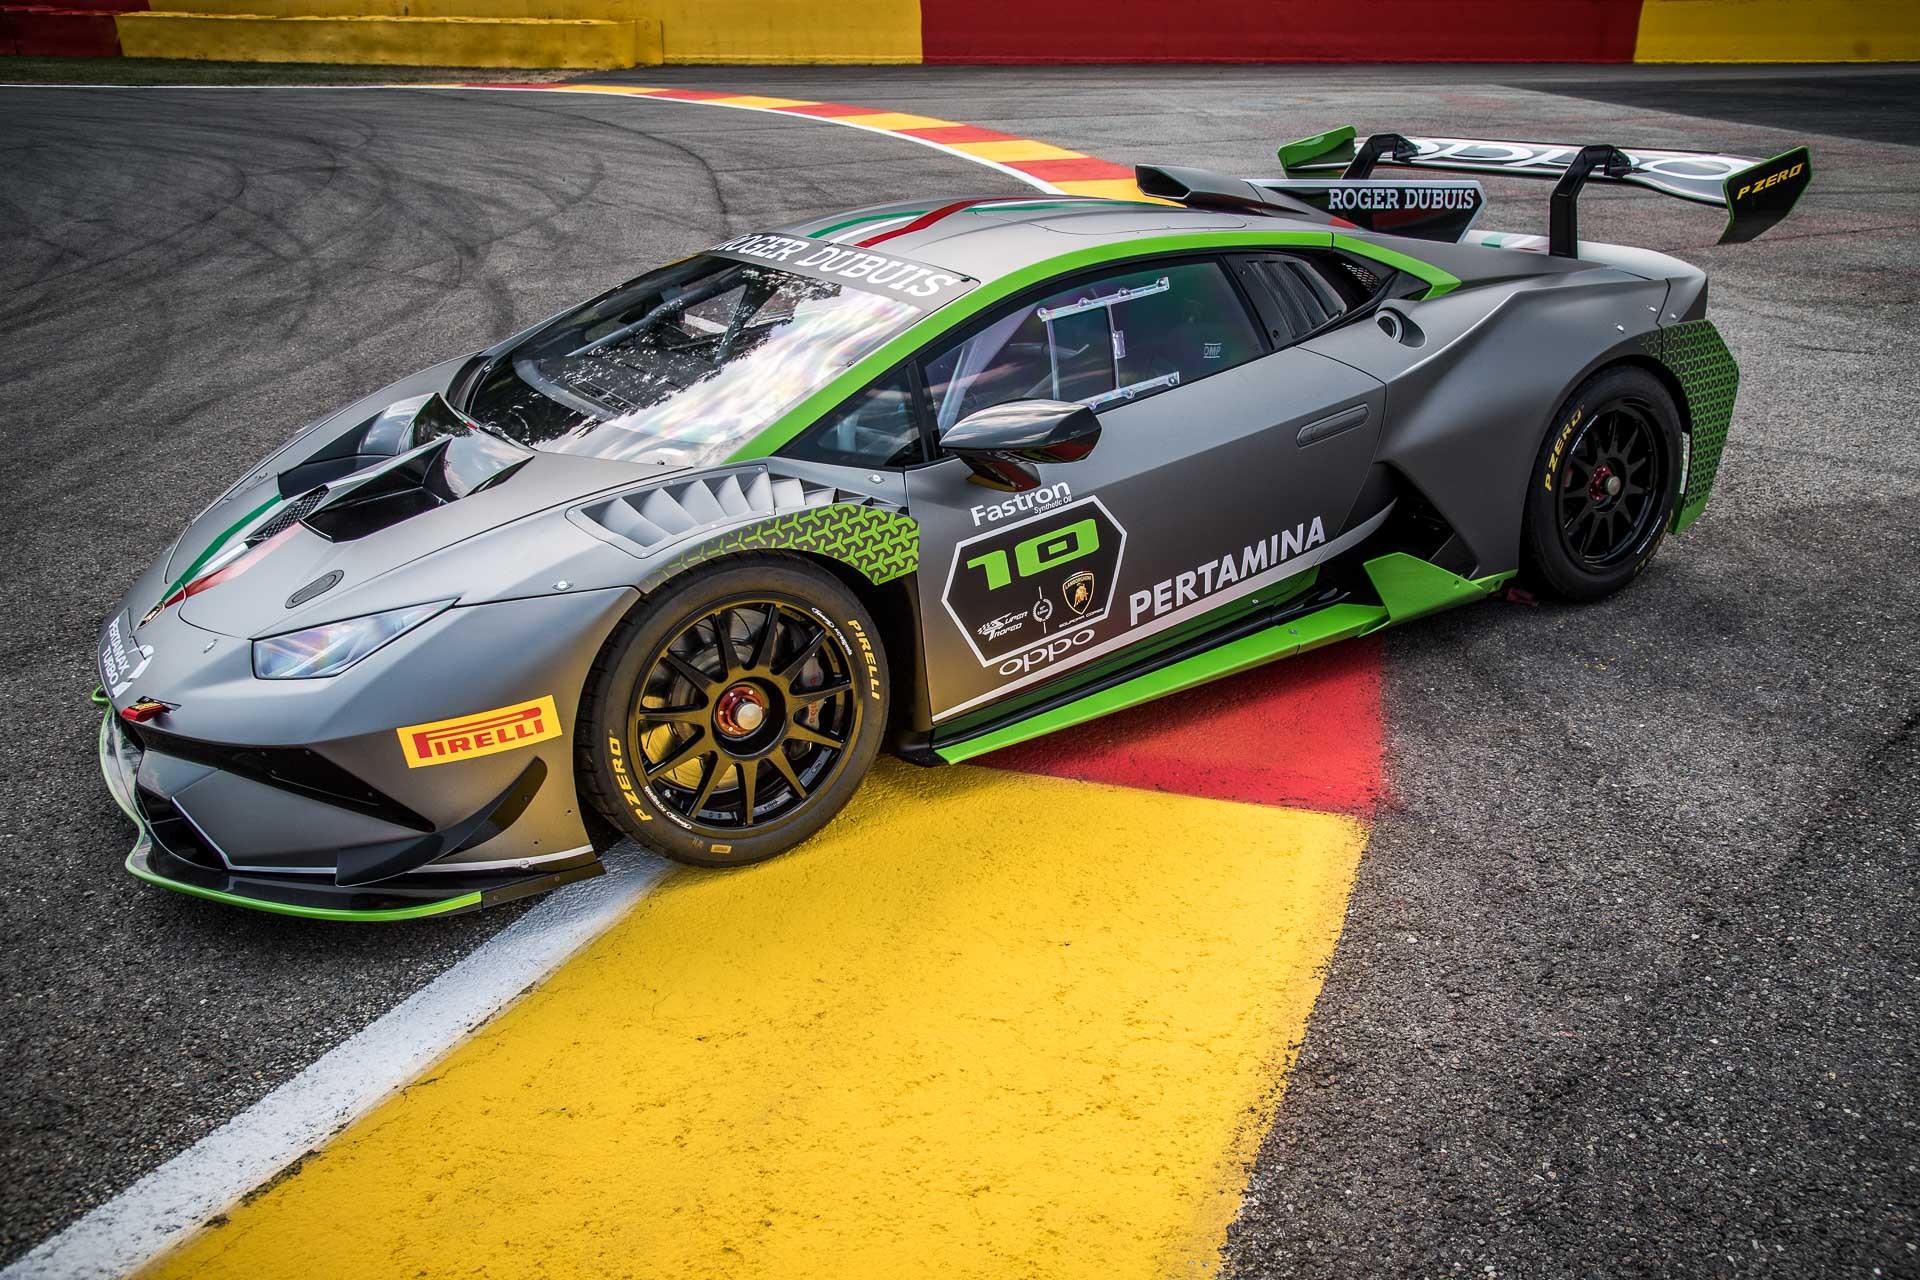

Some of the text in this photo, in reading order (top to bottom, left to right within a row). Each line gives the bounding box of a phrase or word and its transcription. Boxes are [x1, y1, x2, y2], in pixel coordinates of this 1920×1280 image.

[1328, 188, 1475, 210] ROGER DUBUIS
[1737, 162, 1804, 200] P ZERO
[704, 233, 961, 297] ROGER DUBUIS
[1203, 345, 1221, 357] OMP
[1544, 408, 1583, 491] P ZERO
[970, 481, 1071, 527] Fastron
[1034, 494, 1073, 515] Synthetic Oil
[966, 518, 1100, 591] 10
[1129, 516, 1326, 627] PERTAMINA
[102, 645, 119, 685] TURBO
[109, 616, 130, 675] PERTAMAX
[847, 619, 881, 700] PIRELLI
[999, 628, 1095, 676] oppo
[412, 706, 545, 759] PIRELLI
[609, 736, 653, 821] P ZERO
